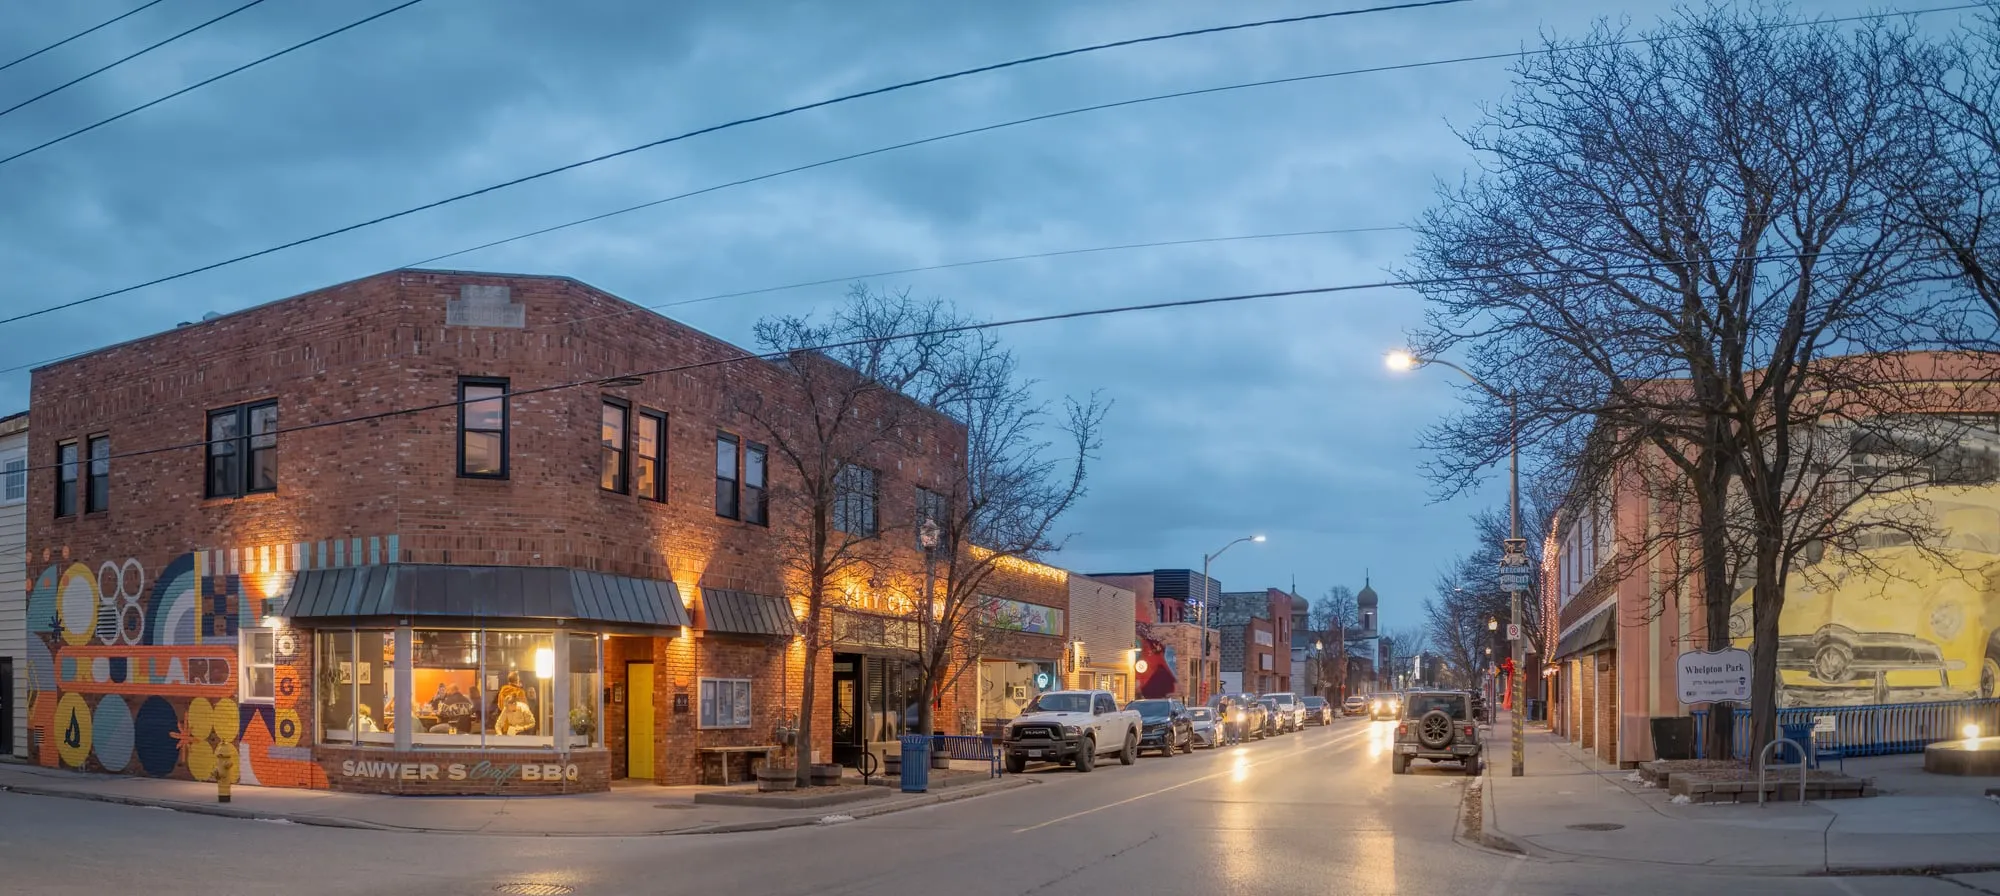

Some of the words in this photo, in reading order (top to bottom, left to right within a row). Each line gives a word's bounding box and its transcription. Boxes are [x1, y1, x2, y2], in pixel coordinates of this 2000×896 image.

[1500, 566, 1529, 574] WELCOME
[60, 656, 231, 686] DROUILLARD
[1685, 665, 1722, 675] Whelpton
[1726, 663, 1744, 672] Park
[469, 760, 521, 786] Craft
[521, 763, 578, 782] BBQ
